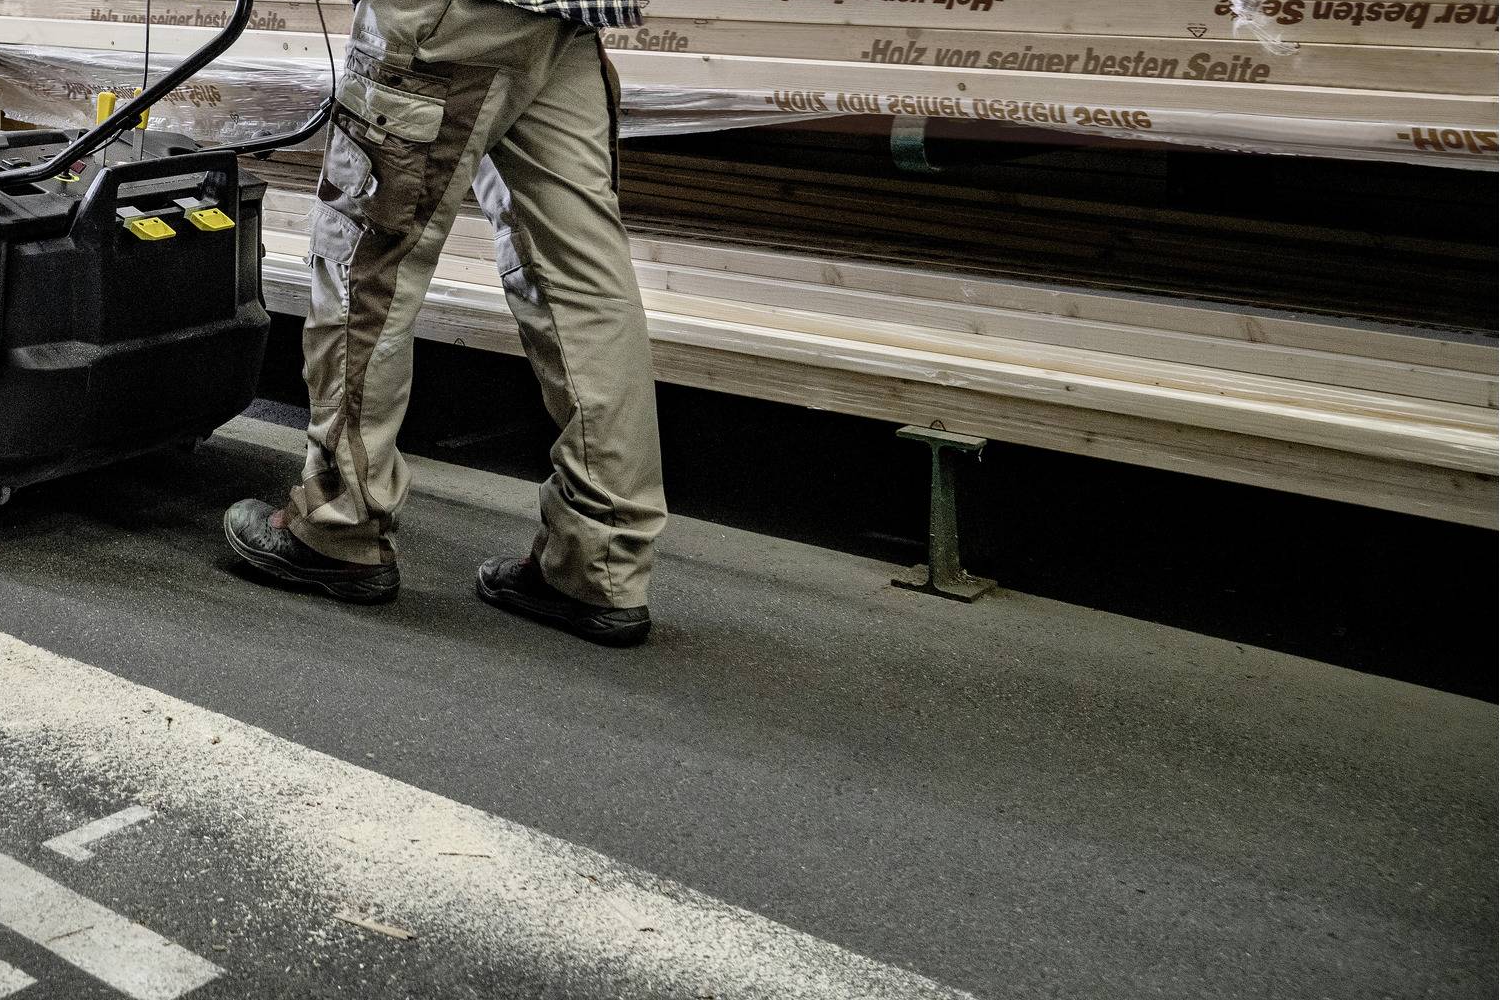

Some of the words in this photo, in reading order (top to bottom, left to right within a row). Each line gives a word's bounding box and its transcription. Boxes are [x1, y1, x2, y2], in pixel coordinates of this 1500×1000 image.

[1314, 1, 1430, 30] besten
[934, 44, 980, 68] von
[987, 46, 1079, 74] seiner
[1082, 48, 1179, 79] besten
[1183, 52, 1270, 83] Seite
